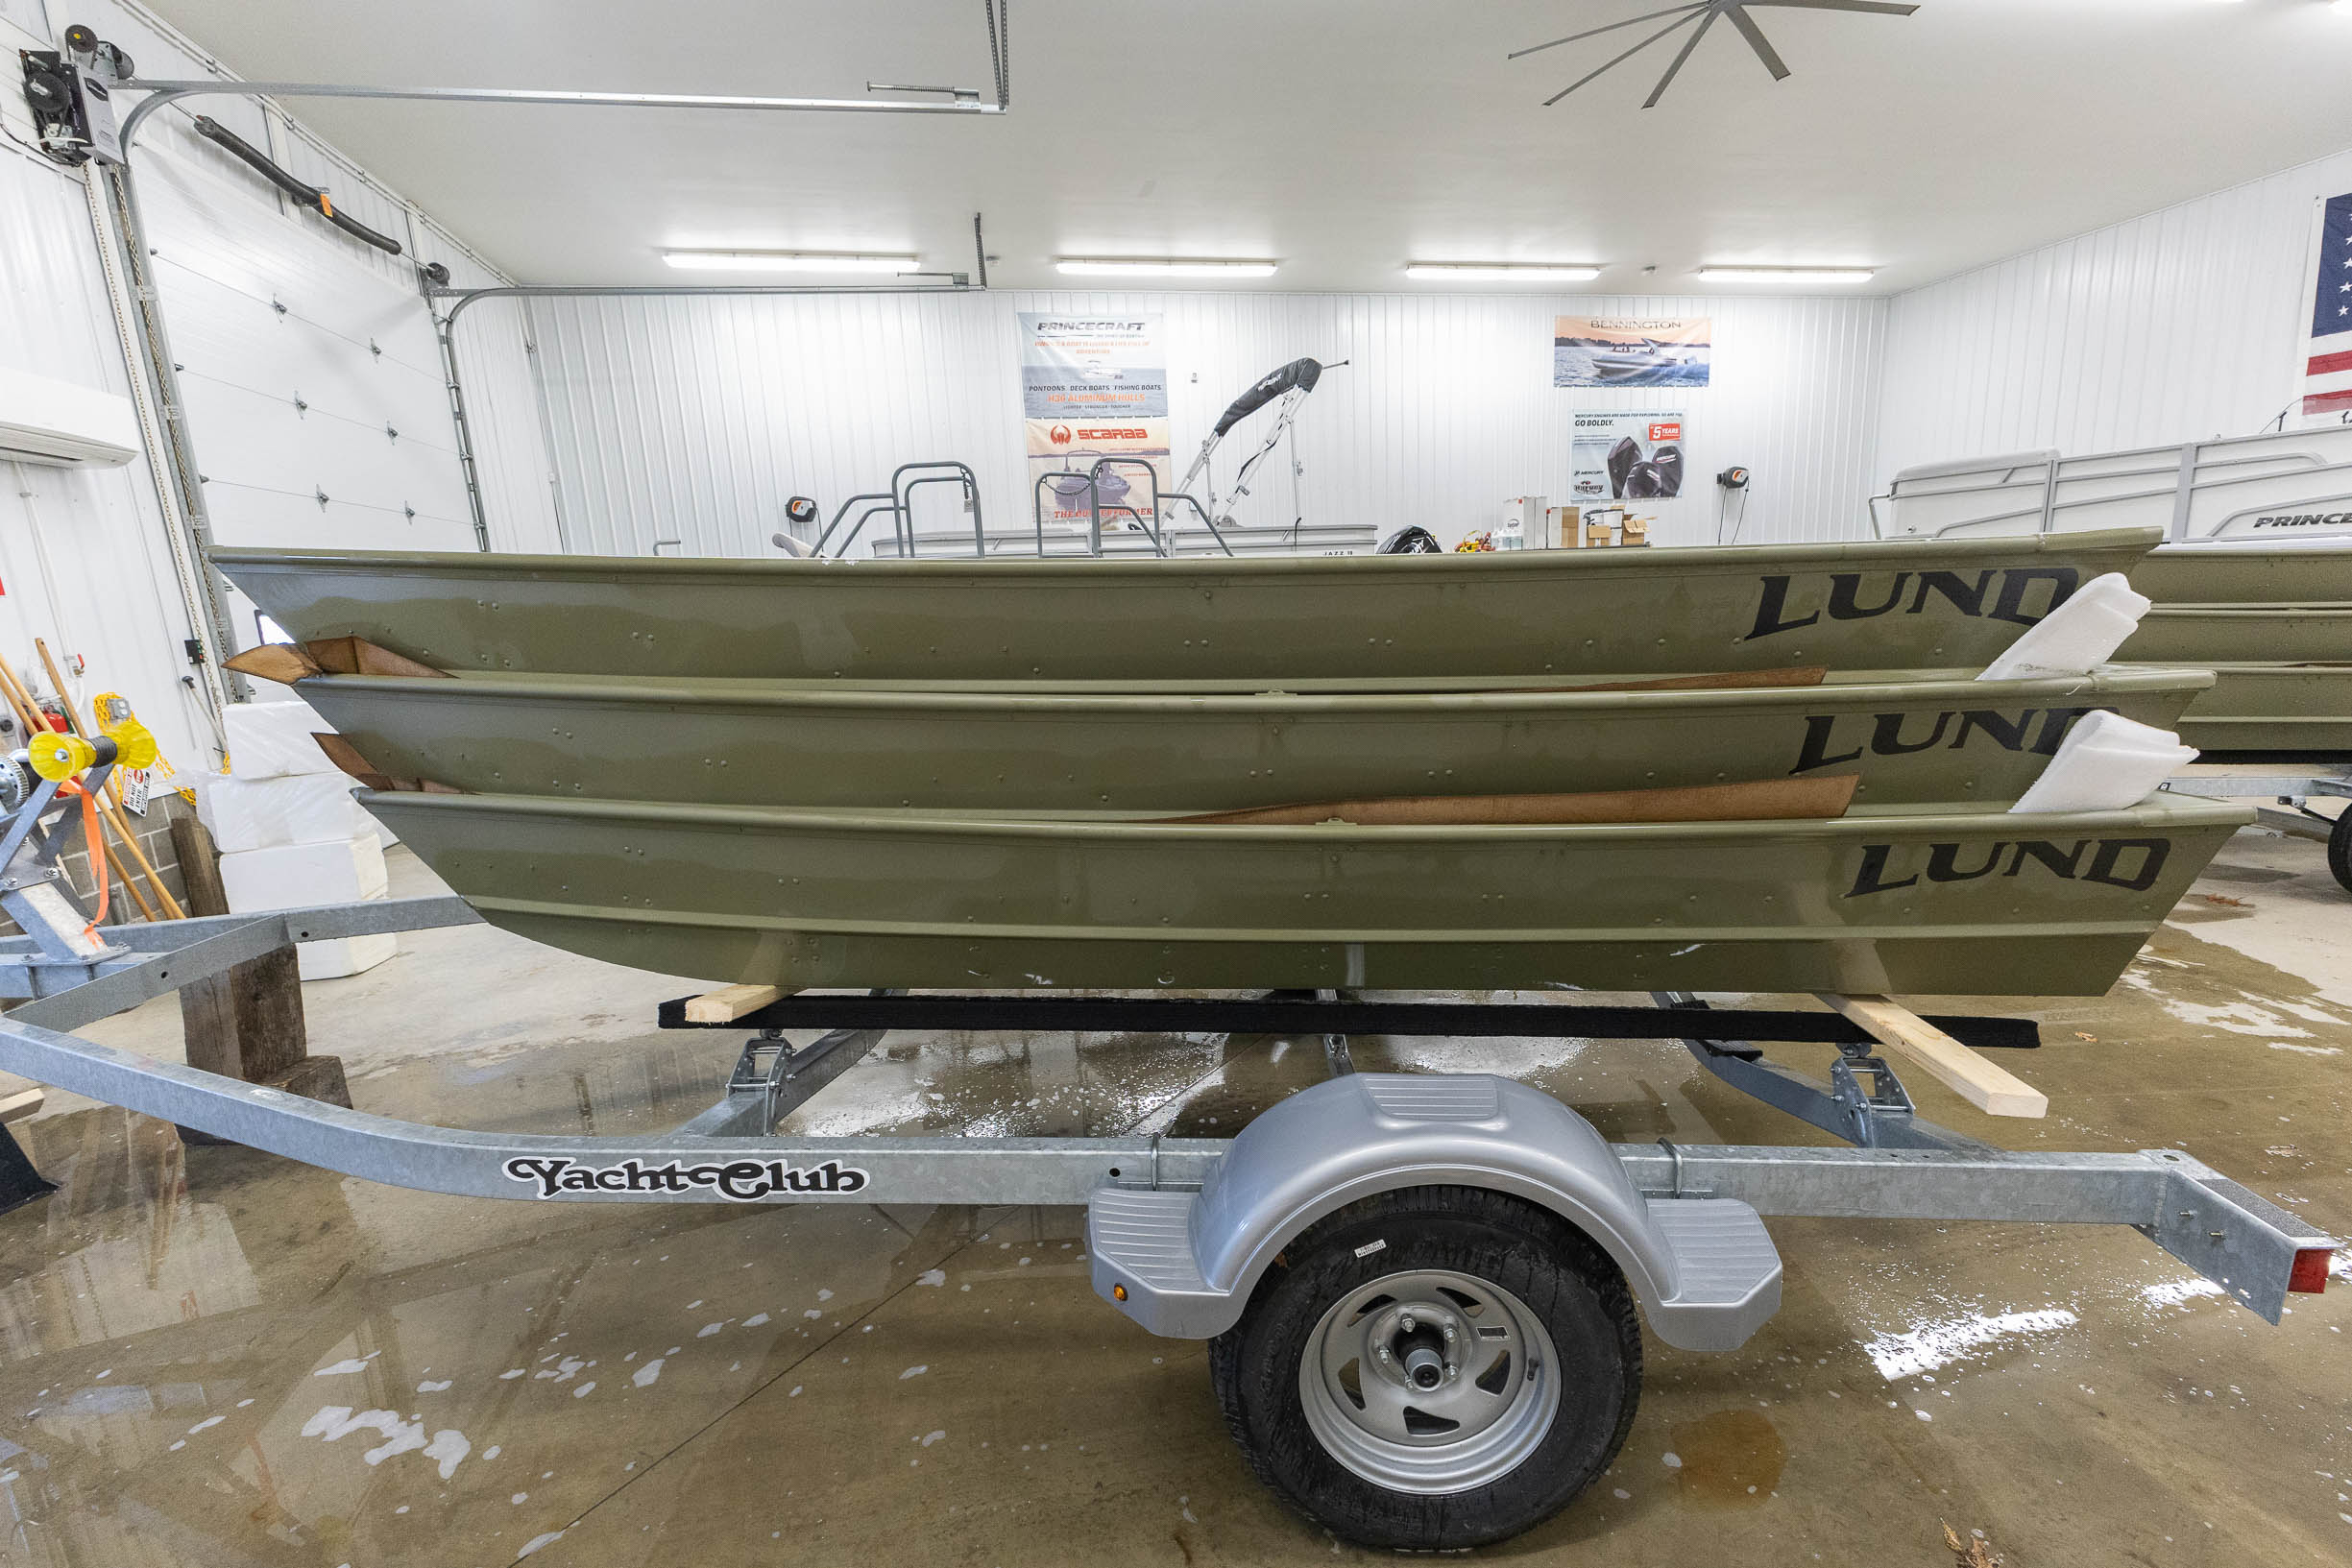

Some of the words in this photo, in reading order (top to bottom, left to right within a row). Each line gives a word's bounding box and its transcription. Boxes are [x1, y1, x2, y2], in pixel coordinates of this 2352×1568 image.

[1037, 322, 1145, 331] PRINCECRAFT
[1590, 320, 1681, 329] BENNINGTON
[1068, 393, 1116, 402] ALUMINUM
[1118, 393, 1145, 402] HULLS
[1077, 428, 1148, 440] SCARAB
[1653, 425, 1661, 439] 5
[1054, 510, 1075, 519] THE
[1744, 567, 2079, 640] LUND
[1844, 838, 2170, 899] LUND
[507, 1159, 690, 1196] Yacht
[689, 1158, 865, 1199] Club
